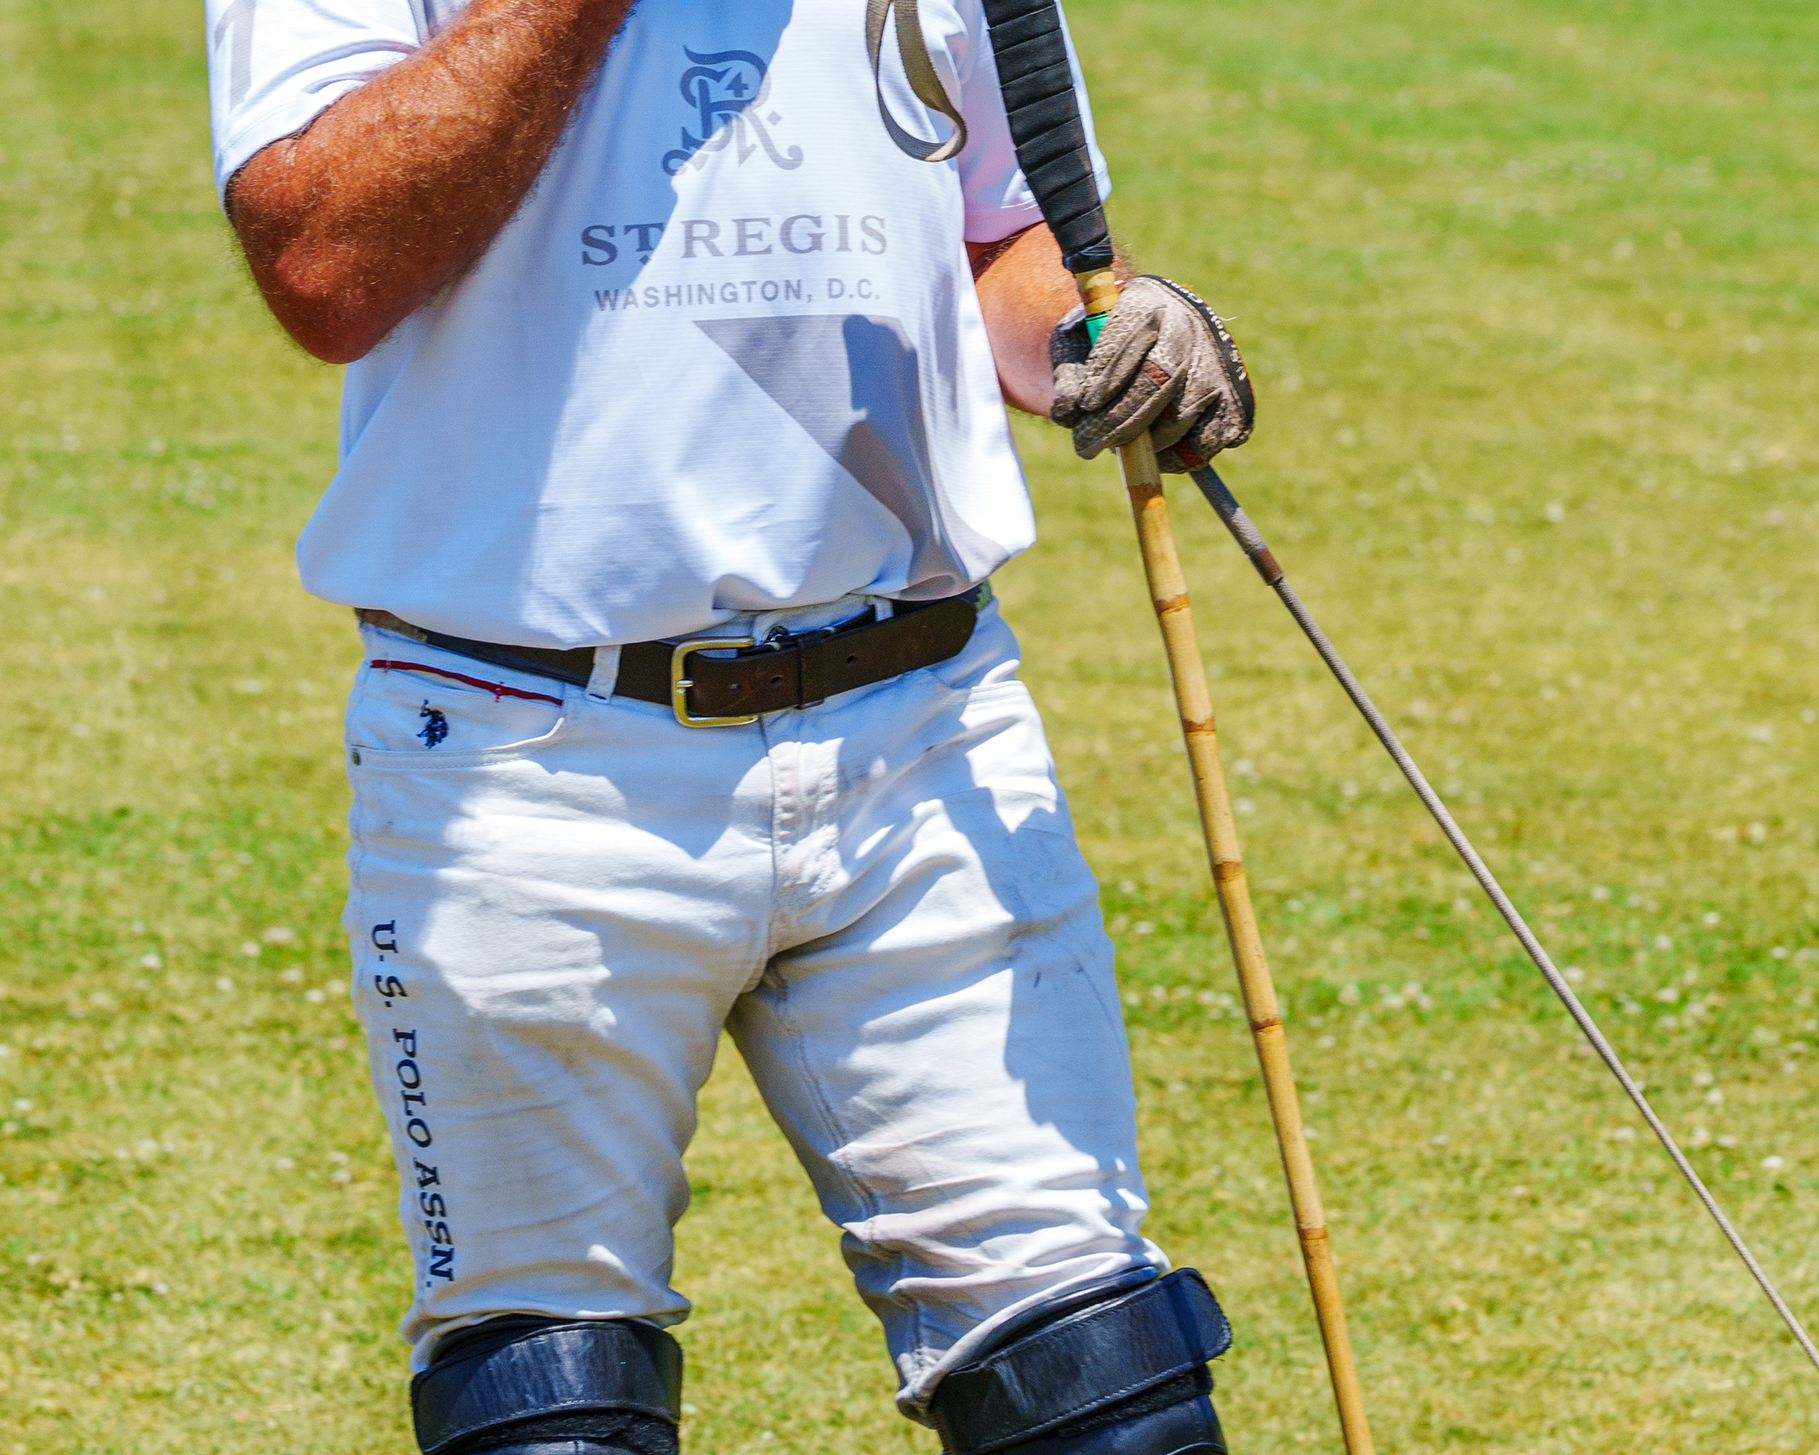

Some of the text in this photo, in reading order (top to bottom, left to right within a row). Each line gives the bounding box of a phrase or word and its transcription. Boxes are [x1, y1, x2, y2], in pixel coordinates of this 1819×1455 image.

[680, 214, 887, 259] REGIS
[594, 278, 879, 311] WASHINGTON, D.C.
[1205, 306, 1231, 342] Polo
[392, 1028, 433, 1148] POLO
[412, 1156, 455, 1288] ASSN.
